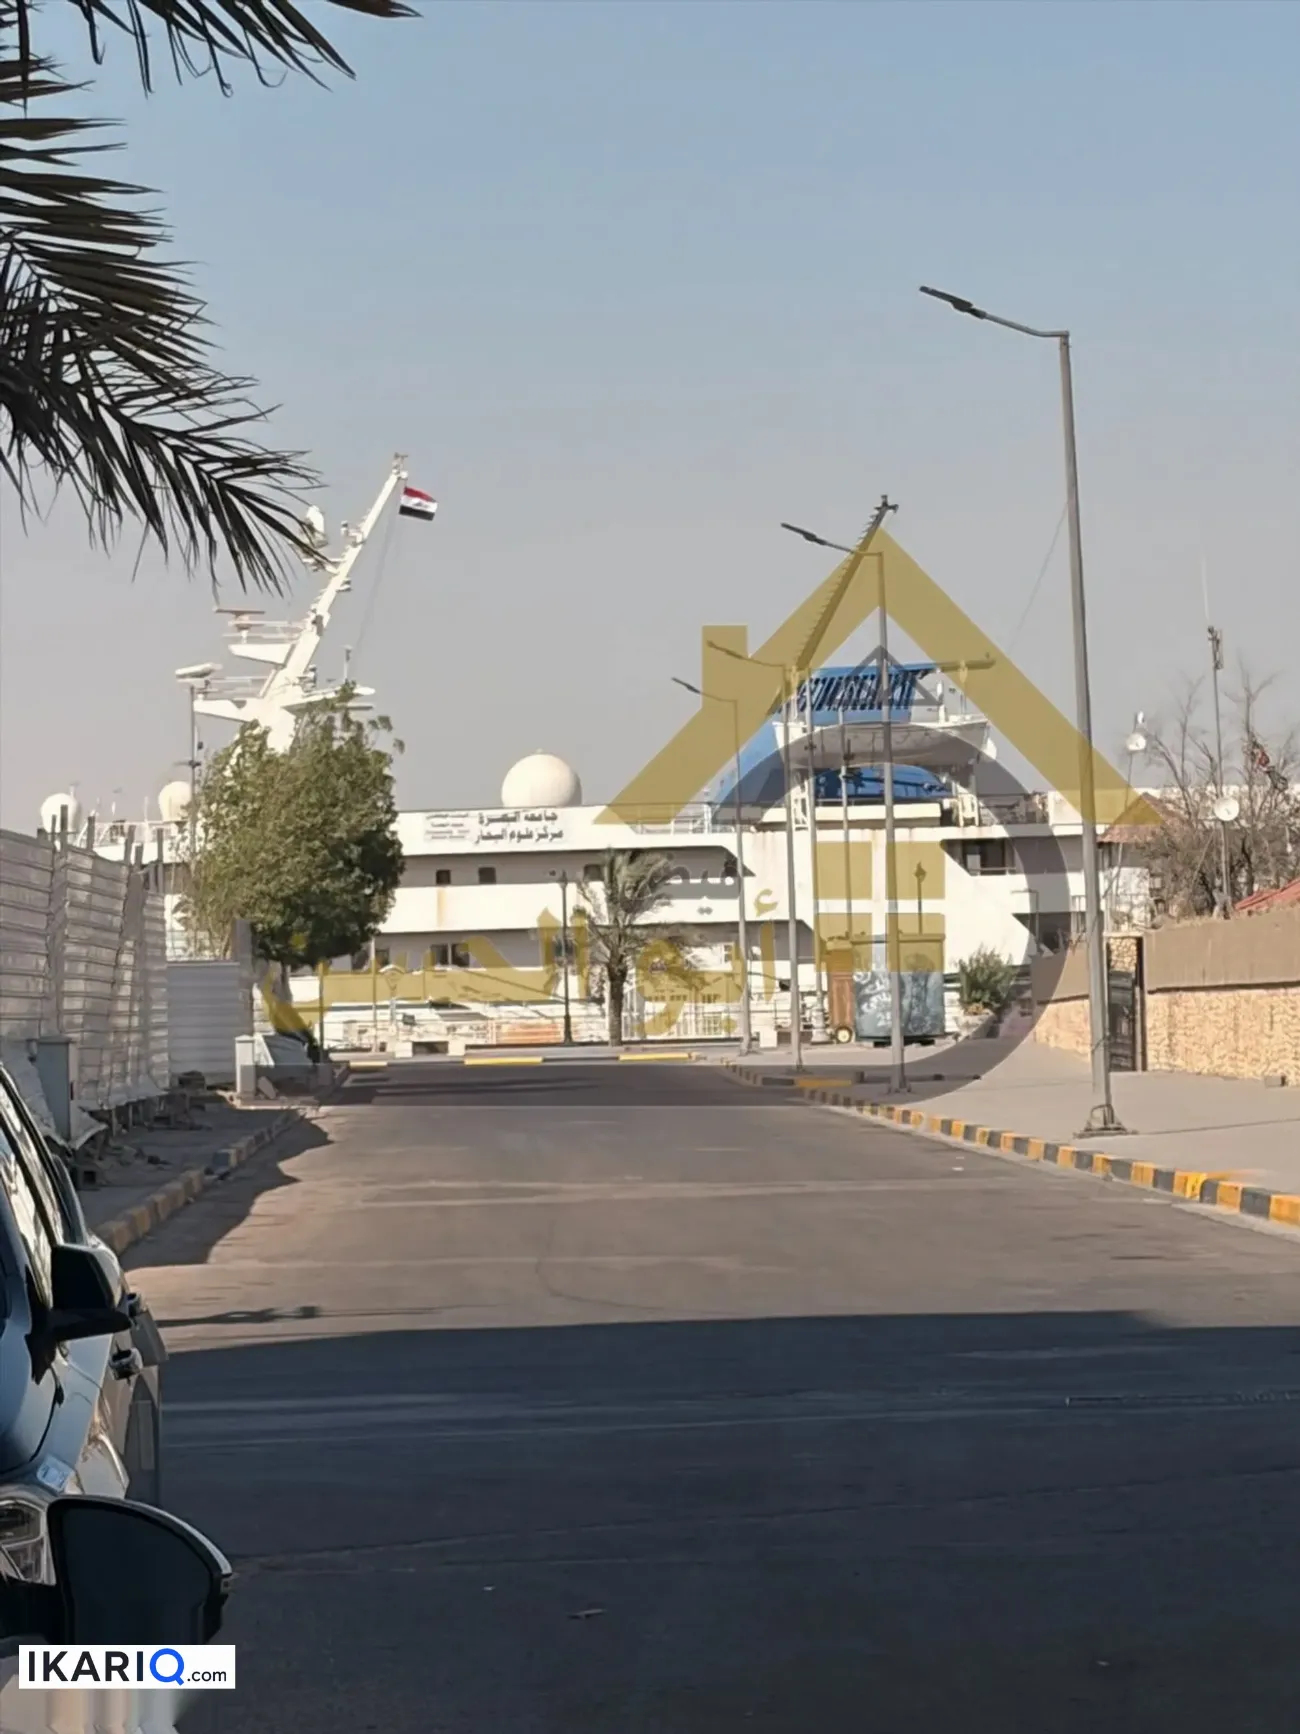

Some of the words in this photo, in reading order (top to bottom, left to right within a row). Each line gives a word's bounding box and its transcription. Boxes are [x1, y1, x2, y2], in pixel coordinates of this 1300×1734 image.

[478, 811, 521, 827] البصرة
[474, 828, 507, 846] البحار
[509, 827, 534, 844] علوم
[535, 826, 564, 842] مركز
